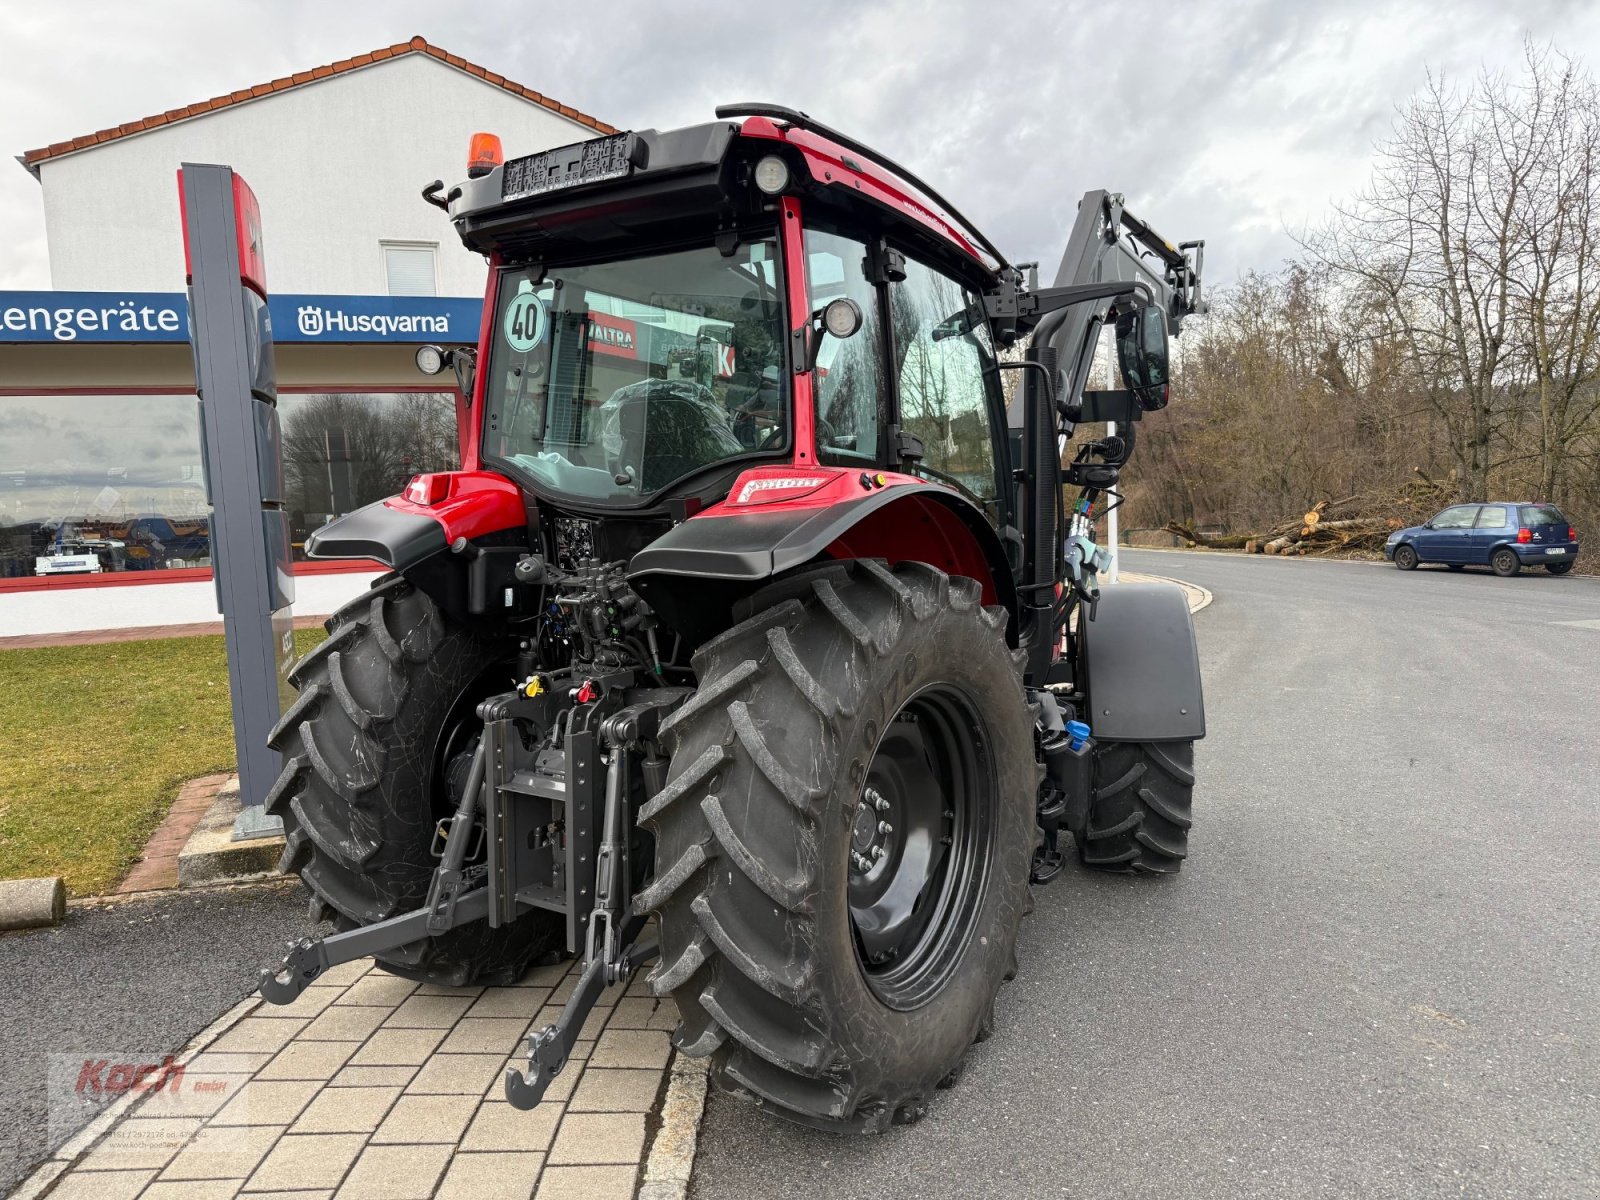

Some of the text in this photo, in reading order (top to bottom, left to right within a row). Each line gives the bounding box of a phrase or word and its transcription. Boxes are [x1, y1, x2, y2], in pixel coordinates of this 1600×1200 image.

[0, 301, 179, 341] engeräte
[325, 310, 449, 335] Husqvarna
[511, 303, 538, 341] 40
